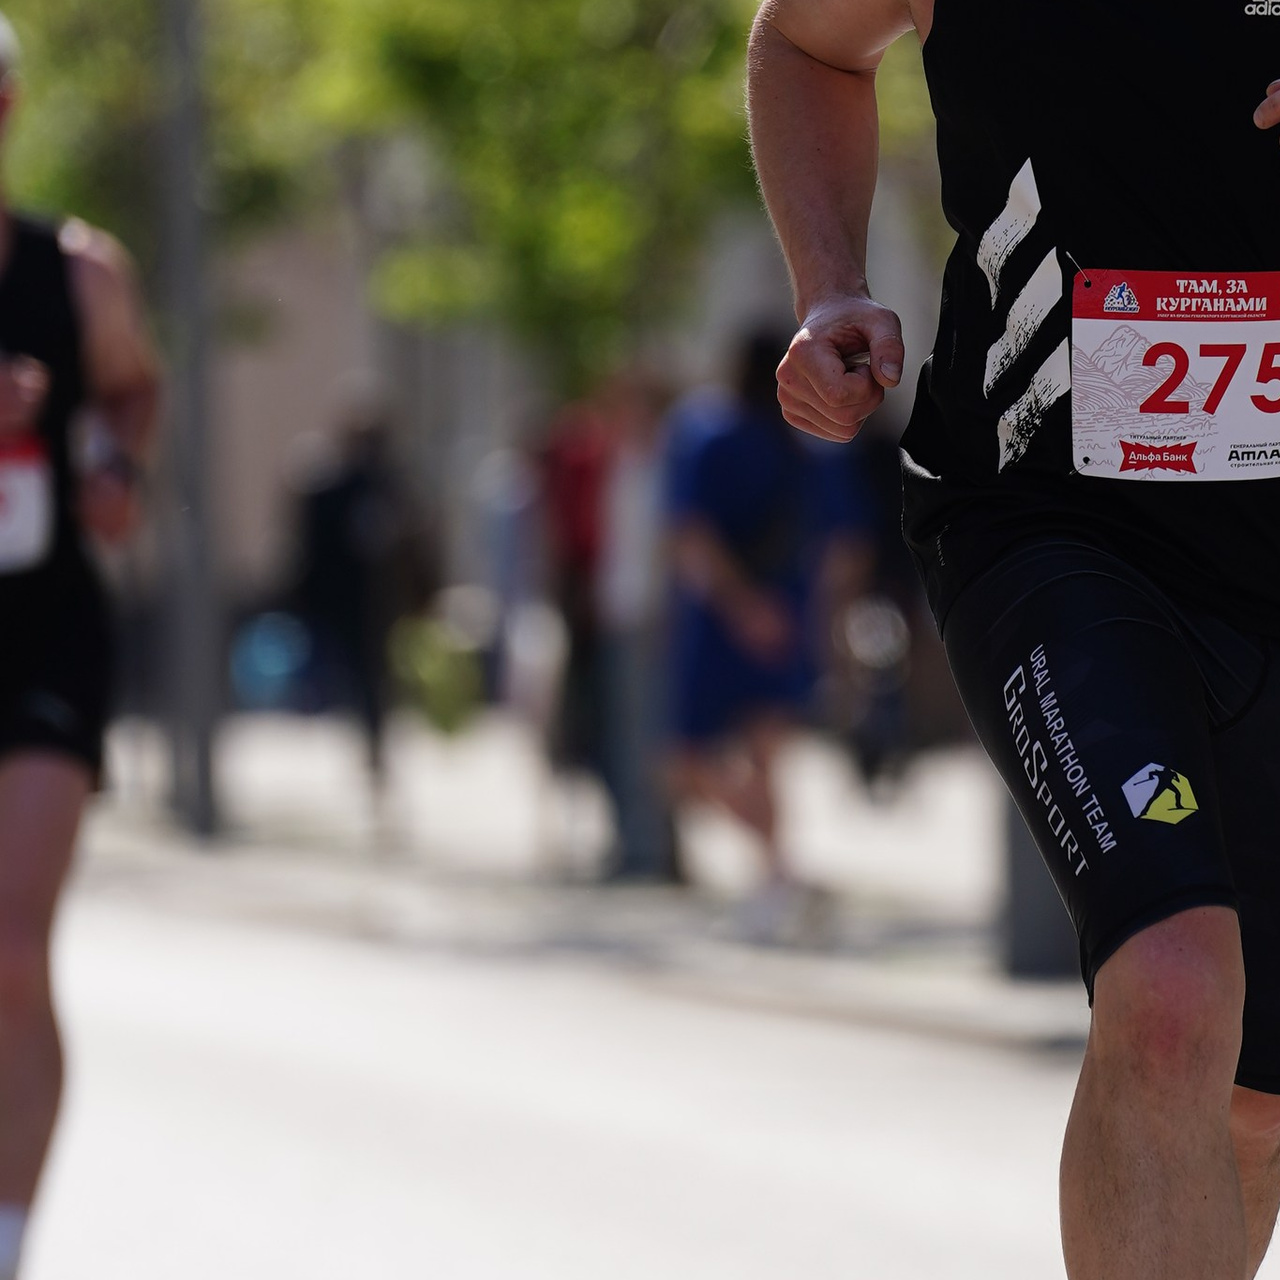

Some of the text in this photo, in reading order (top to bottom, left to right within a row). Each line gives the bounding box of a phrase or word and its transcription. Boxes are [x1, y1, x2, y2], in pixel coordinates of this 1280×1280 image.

[1176, 279, 1249, 296] ТАМ, ЗА
[1156, 297, 1267, 312] КУРГАНАМИ
[1129, 451, 1188, 463] Альфа Банк
[1030, 644, 1117, 853] URAL MARATHON TEAM
